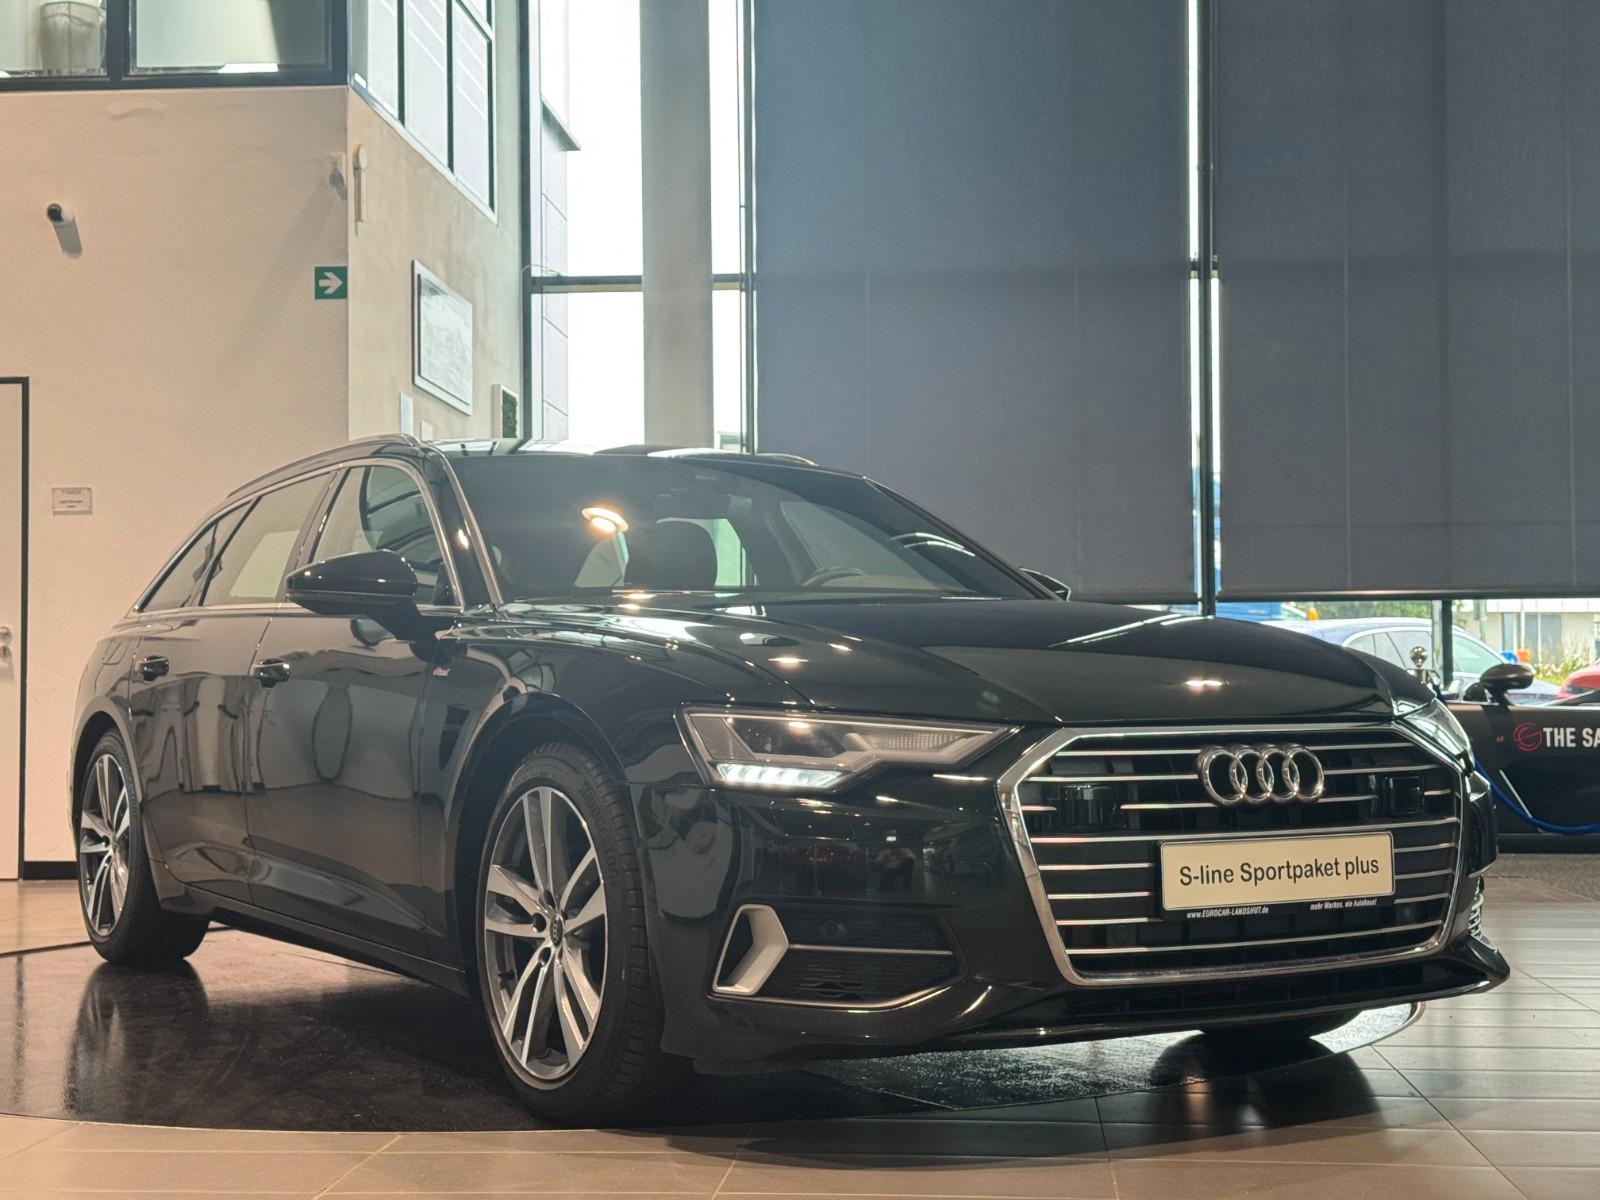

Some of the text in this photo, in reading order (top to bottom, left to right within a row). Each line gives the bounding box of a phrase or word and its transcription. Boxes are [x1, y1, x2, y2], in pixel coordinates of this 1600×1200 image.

[1542, 727, 1577, 748] THE
[1179, 855, 1379, 887] S-line Sportpaket plus
